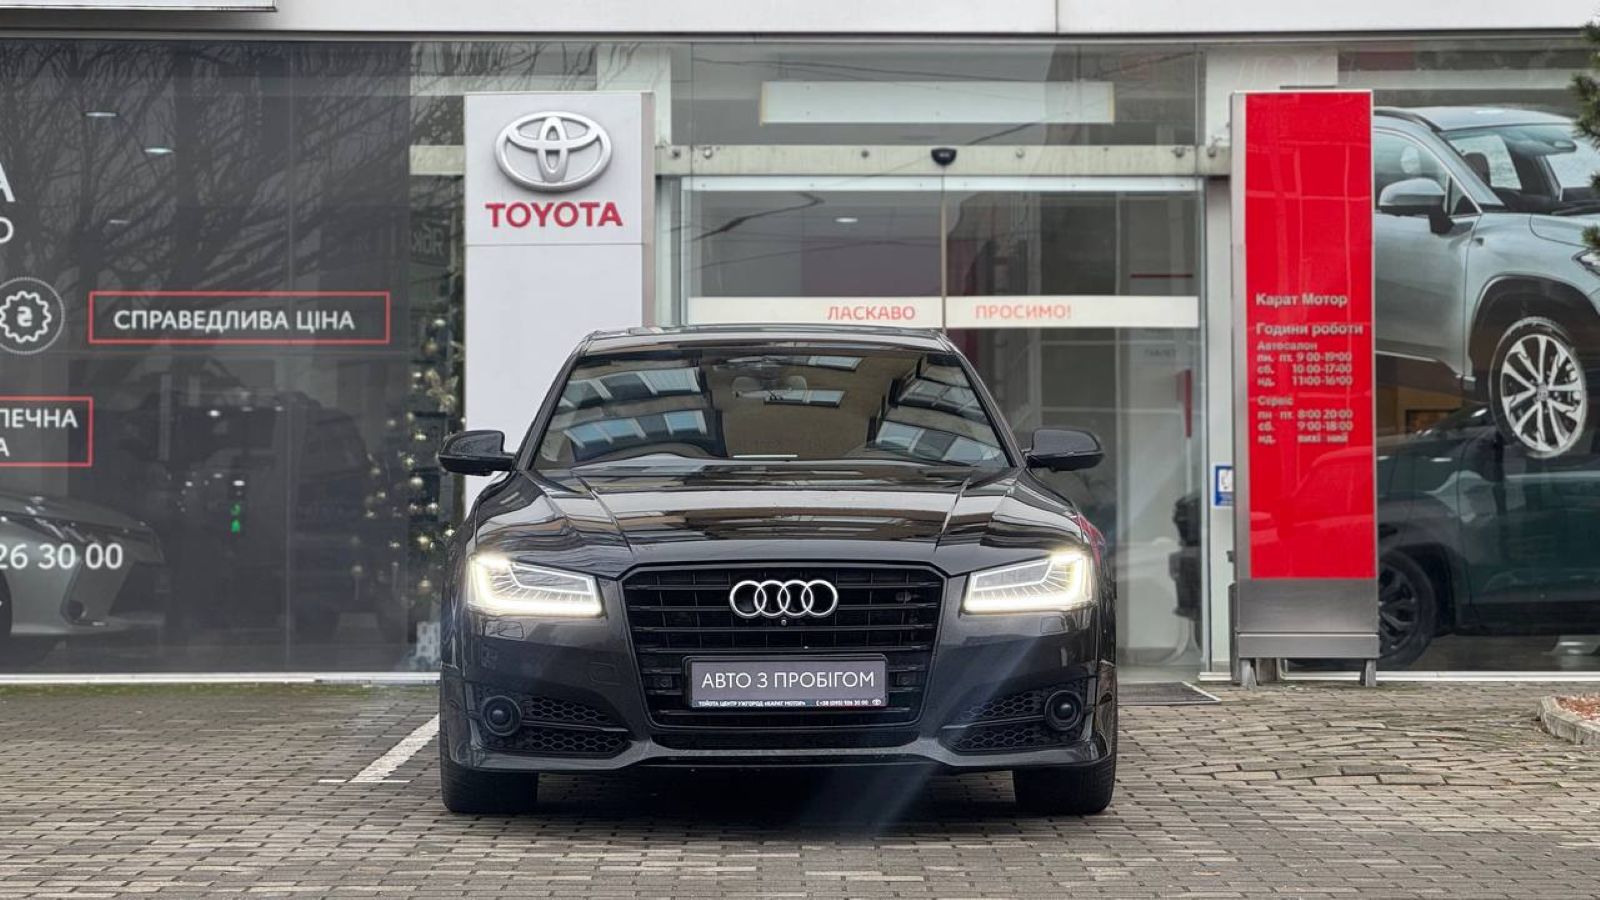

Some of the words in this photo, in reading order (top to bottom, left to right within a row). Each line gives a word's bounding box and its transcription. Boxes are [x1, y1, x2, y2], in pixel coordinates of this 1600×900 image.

[485, 201, 623, 228] TOYOTA
[1256, 293, 1298, 308] Карат
[1302, 293, 1348, 308] Мотор
[113, 310, 290, 333] СПРАВЕДЛИВА
[296, 310, 355, 333] ЦІНА
[827, 305, 916, 321] ЛАСКАВО
[975, 304, 1073, 320] ПРОСИМО!
[1256, 322, 1308, 336] Години
[1312, 323, 1363, 337] роботи
[38, 543, 76, 569] 30
[85, 543, 123, 569] 00
[702, 672, 752, 689] АВТО
[774, 671, 875, 688] ПРОБІГОМ
